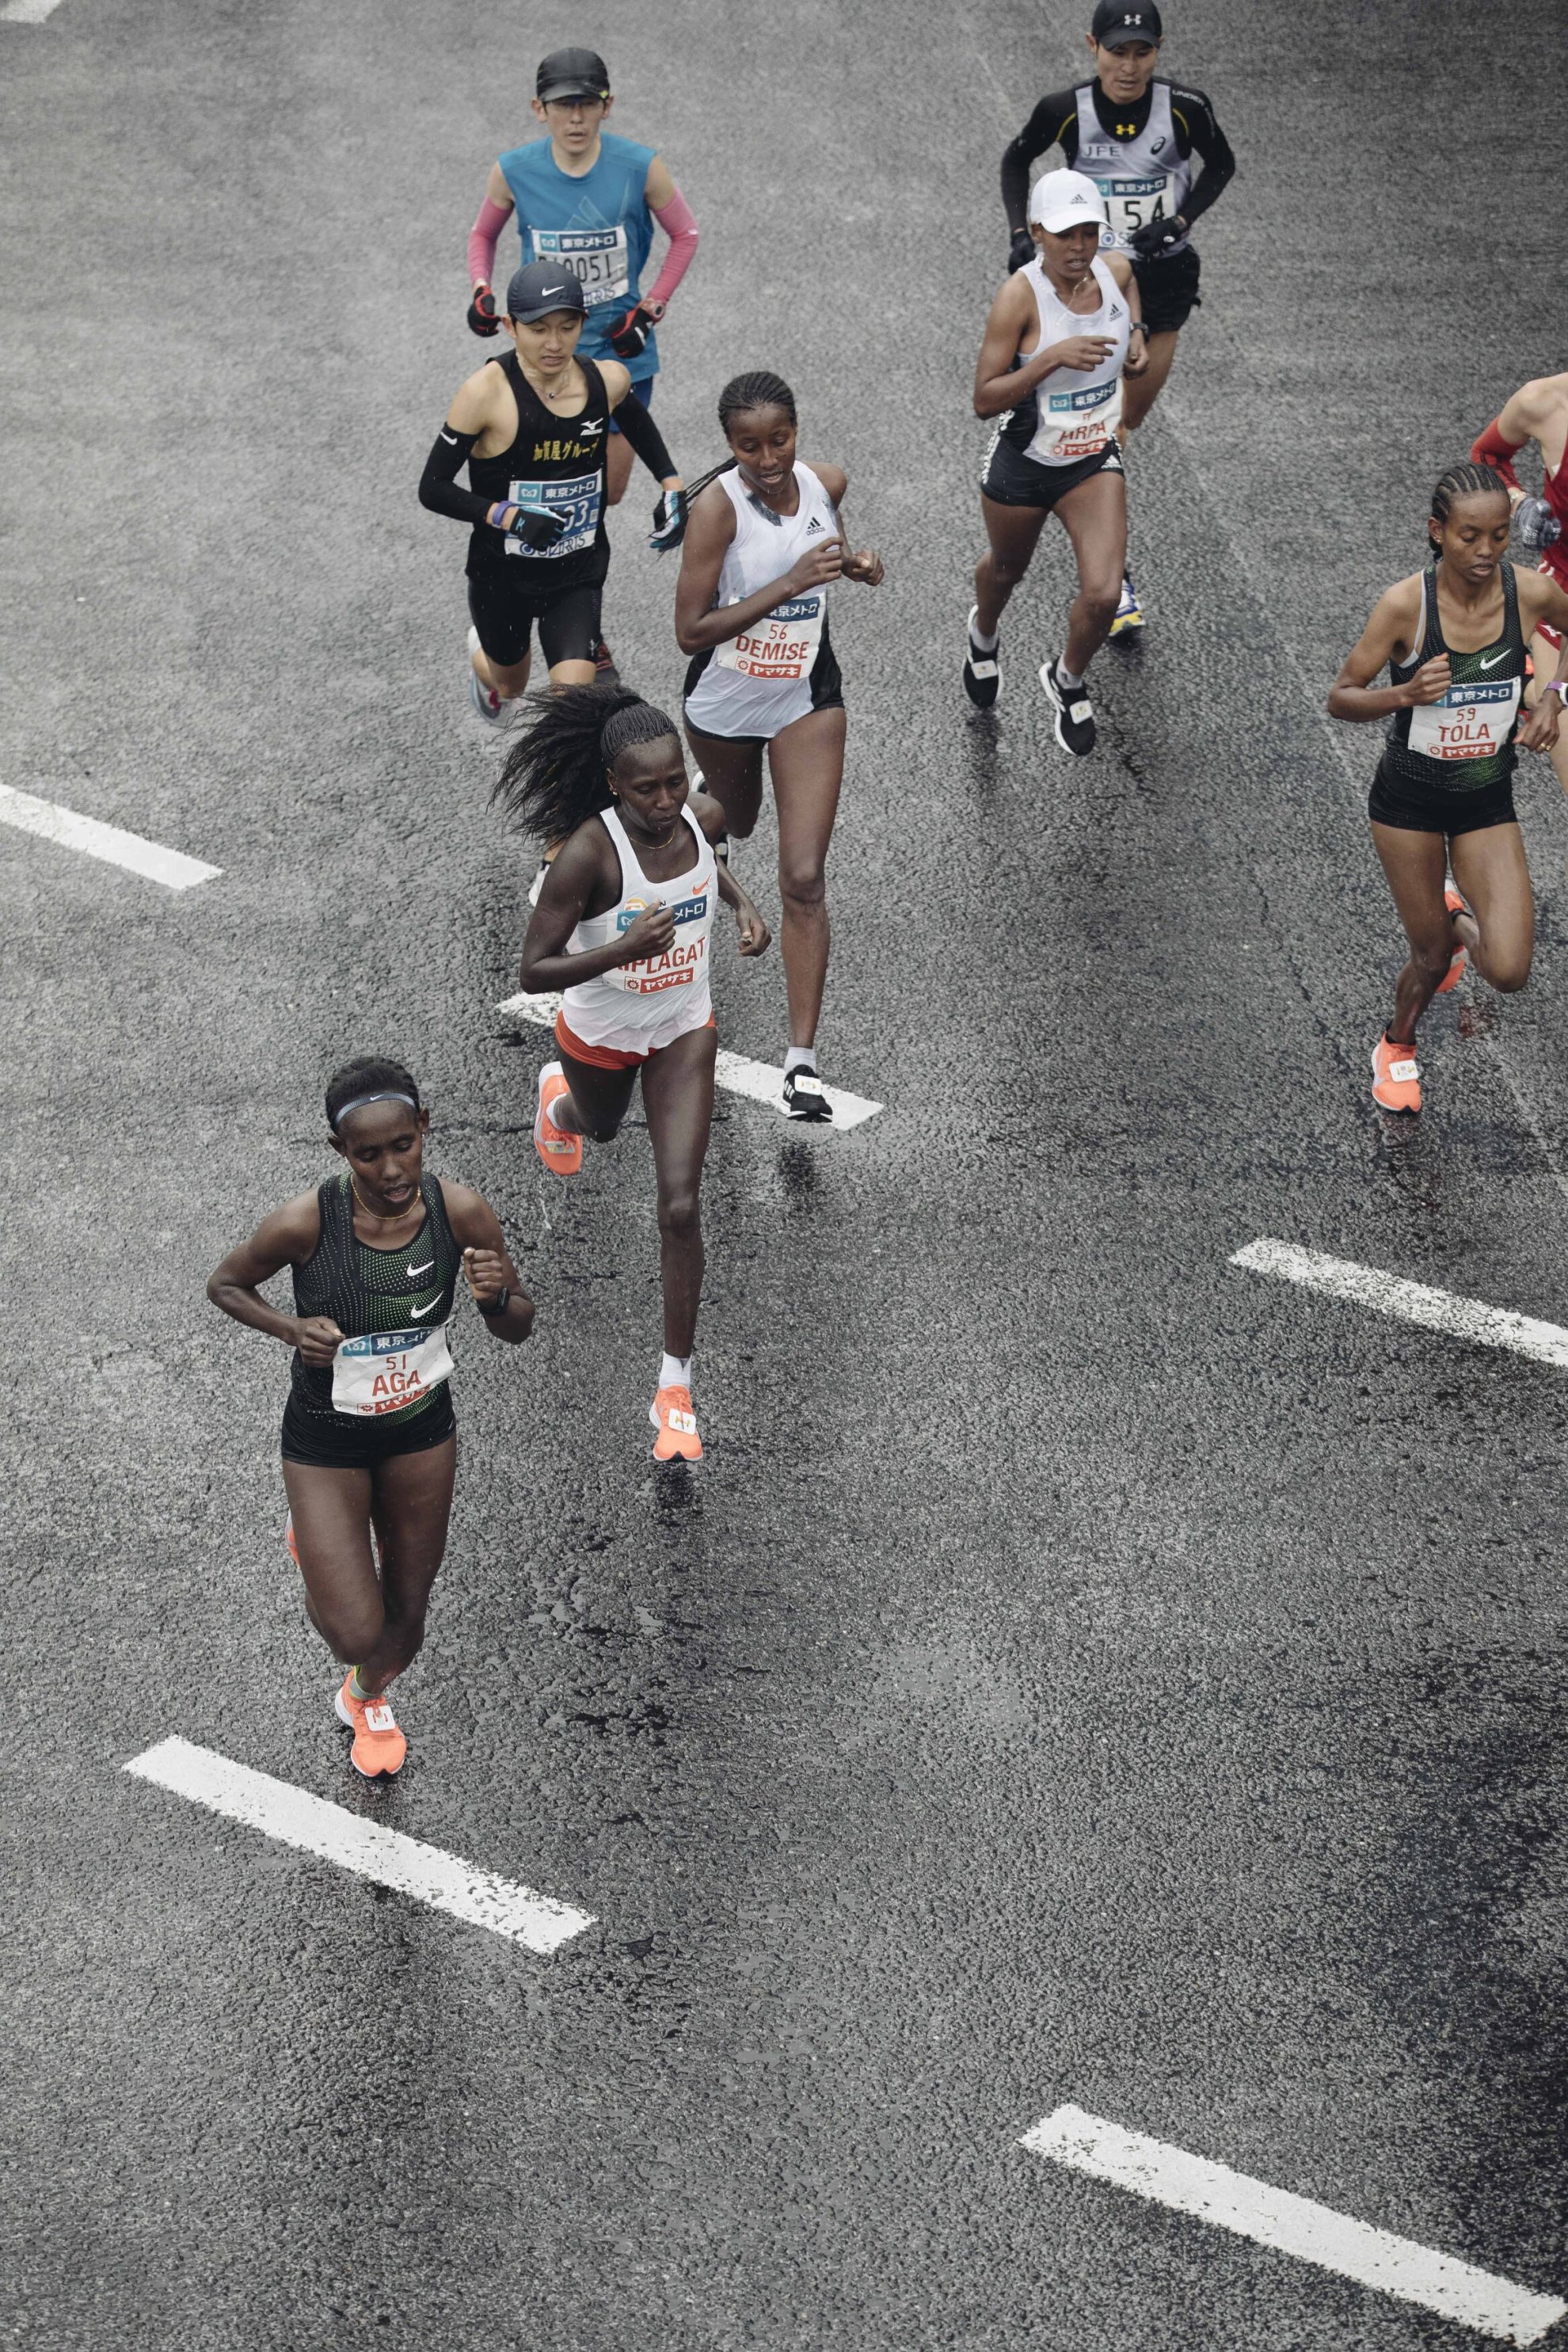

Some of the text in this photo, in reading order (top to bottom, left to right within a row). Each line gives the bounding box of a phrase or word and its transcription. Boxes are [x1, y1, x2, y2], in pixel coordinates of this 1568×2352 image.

[1085, 146, 1121, 158] JFE
[1104, 196, 1165, 230] 154
[545, 481, 596, 498] 東京メトロ
[768, 624, 789, 640] 56
[735, 635, 809, 660] DEMISE
[1451, 688, 1509, 703] 東京メトロ
[1456, 707, 1476, 722] 59
[1438, 723, 1490, 743] TOLA
[674, 903, 704, 921] メトロ
[376, 1330, 432, 1349] 東京メト
[386, 1354, 406, 1370] 51
[372, 1370, 421, 1396] AGA
